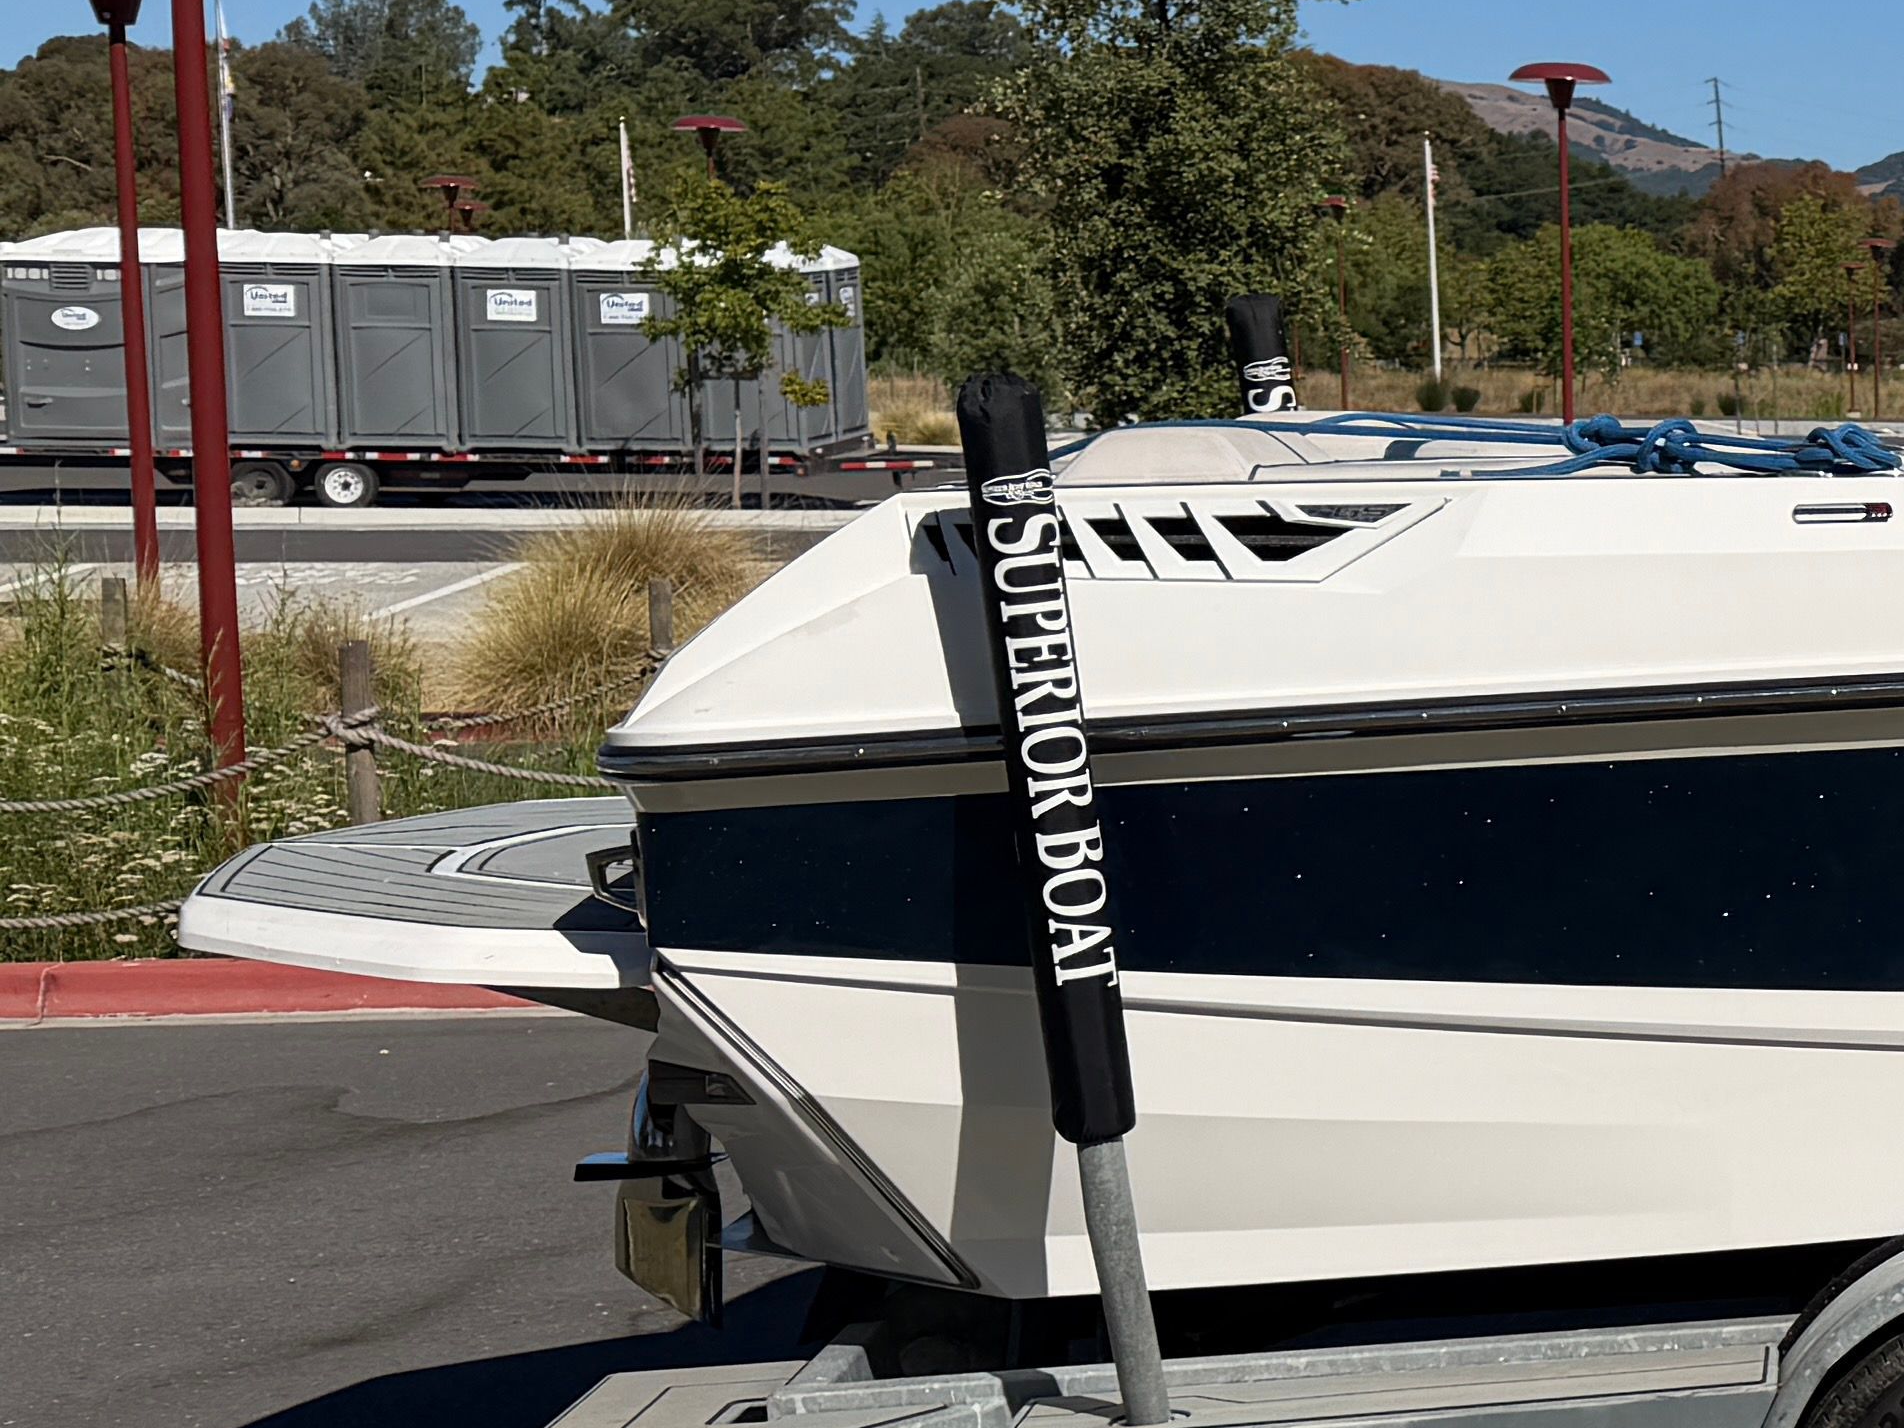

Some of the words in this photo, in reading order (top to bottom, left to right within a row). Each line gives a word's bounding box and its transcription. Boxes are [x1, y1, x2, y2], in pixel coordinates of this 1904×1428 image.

[494, 297, 532, 307] United
[986, 512, 1093, 820] SUPERIOR
[1035, 818, 1119, 988] BOAT
